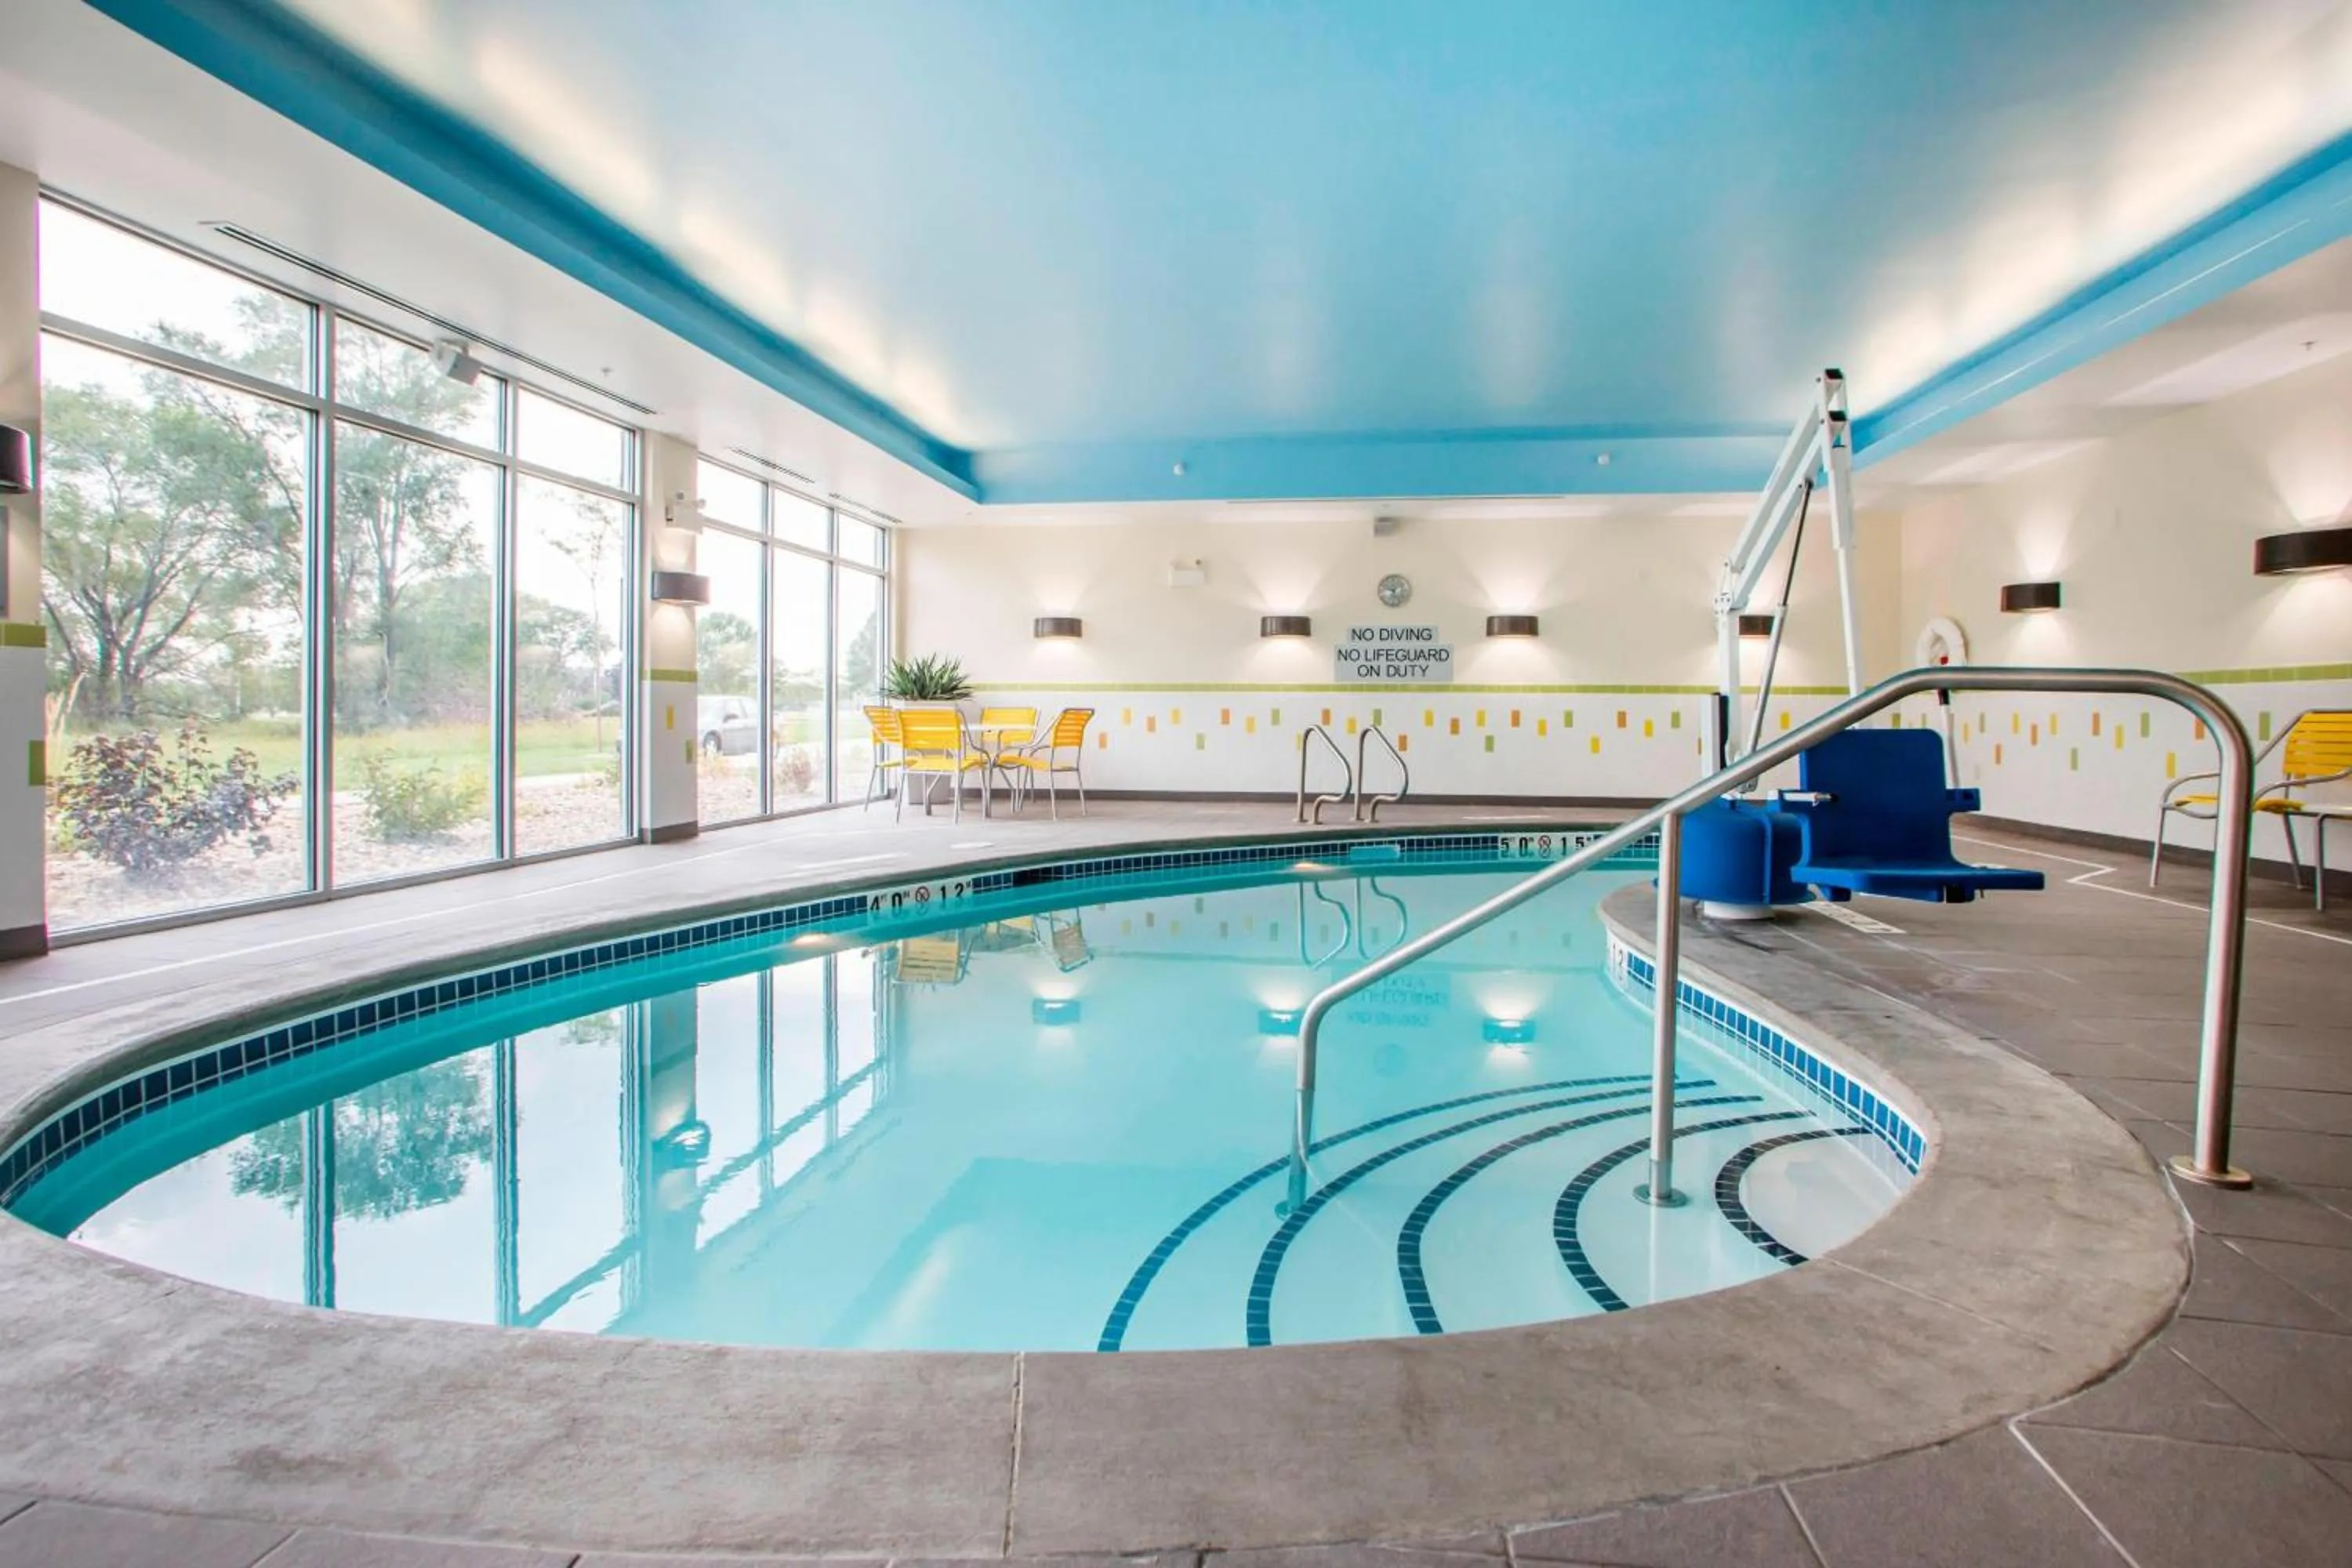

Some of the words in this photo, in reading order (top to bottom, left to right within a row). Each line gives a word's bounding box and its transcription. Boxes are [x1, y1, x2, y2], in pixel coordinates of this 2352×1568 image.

[1351, 628, 1374, 641] NO
[1379, 628, 1432, 641] DIVING
[1337, 648, 1360, 662] NO
[1364, 648, 1450, 662] LIFEGUARD
[1357, 664, 1381, 677] ON
[1386, 665, 1429, 677] DUTY
